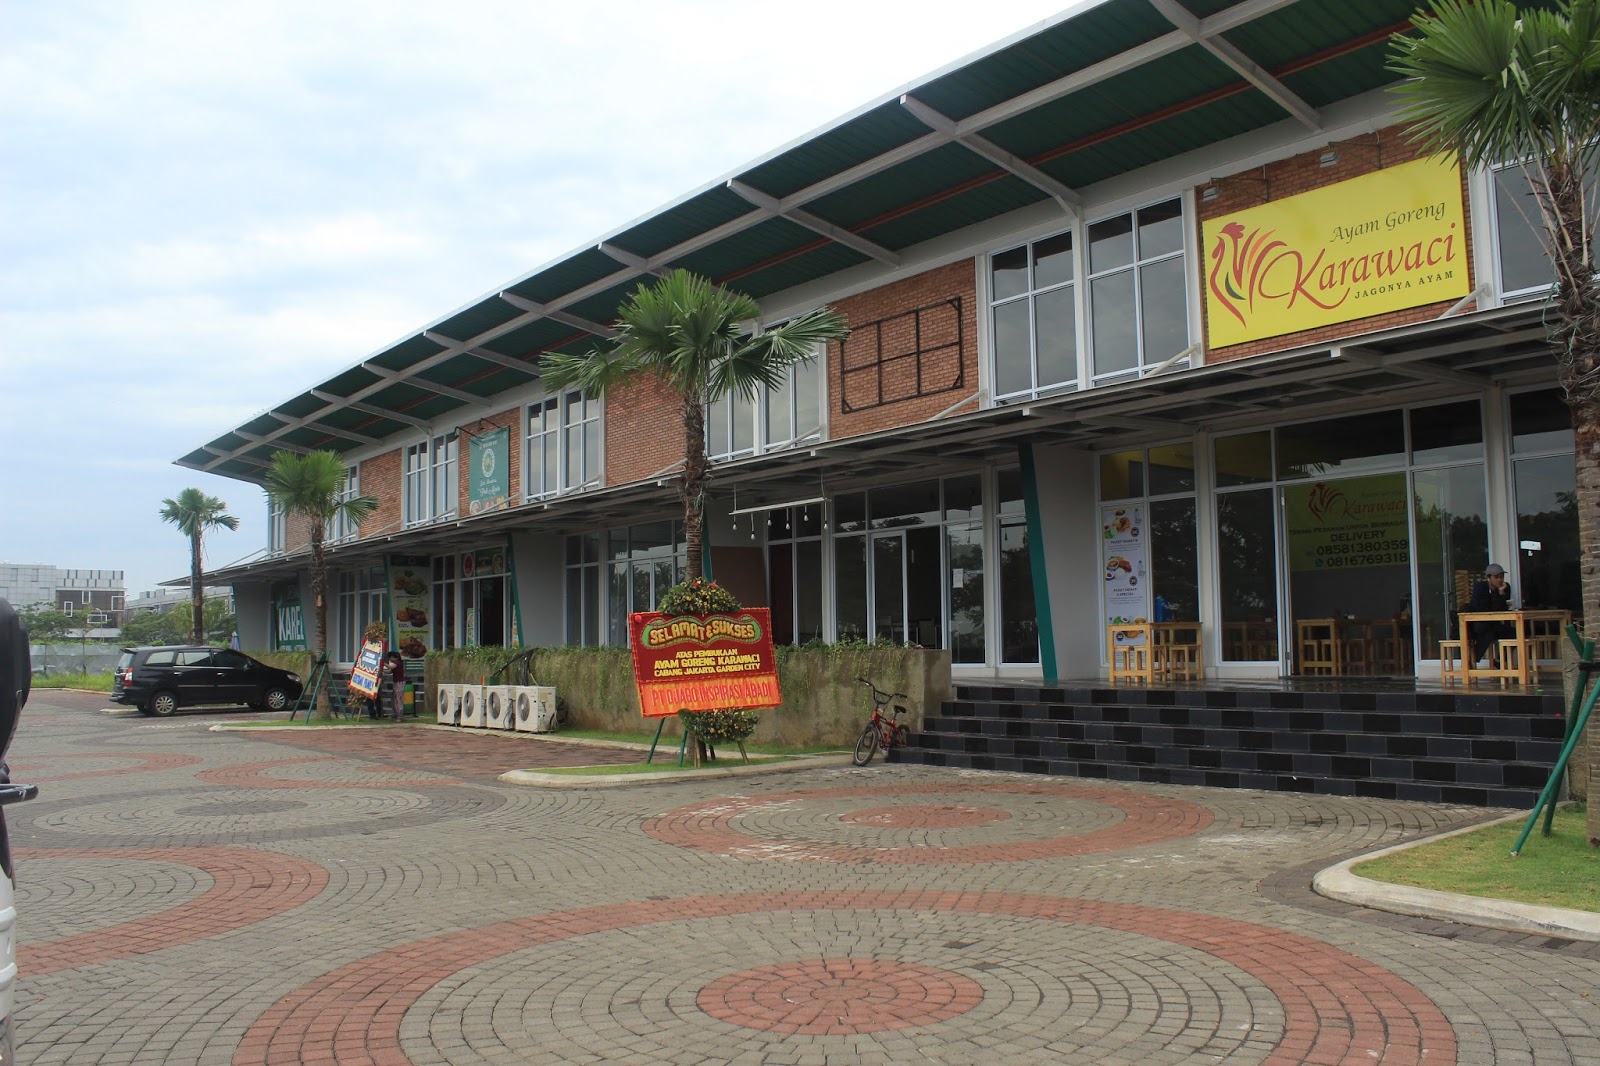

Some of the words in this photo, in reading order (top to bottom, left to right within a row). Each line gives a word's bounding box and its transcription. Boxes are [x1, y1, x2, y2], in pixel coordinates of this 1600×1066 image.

[1330, 220, 1380, 244] Ayam
[1385, 201, 1446, 232] Goreng
[1258, 222, 1456, 310] Karawaci
[1354, 280, 1412, 299] JAGONYA
[1418, 270, 1454, 285] AYAM
[1330, 530, 1387, 542] DELIVERY
[650, 621, 706, 645] SELAMAT
[712, 620, 755, 639] SUKSES
[654, 659, 680, 670] AYAM
[681, 656, 715, 668] GORENG
[717, 653, 761, 666] KARAWACI
[676, 650, 693, 659] ATAS
[694, 648, 738, 658] PEMBUKAAN
[654, 668, 683, 678] CABANG
[684, 666, 716, 676] JAKARTA
[716, 664, 744, 673] GARDEN
[744, 663, 761, 671] CITY
[666, 686, 698, 704] DJAGO
[699, 683, 742, 702] INSPIRASI
[744, 680, 771, 698] ABADI
